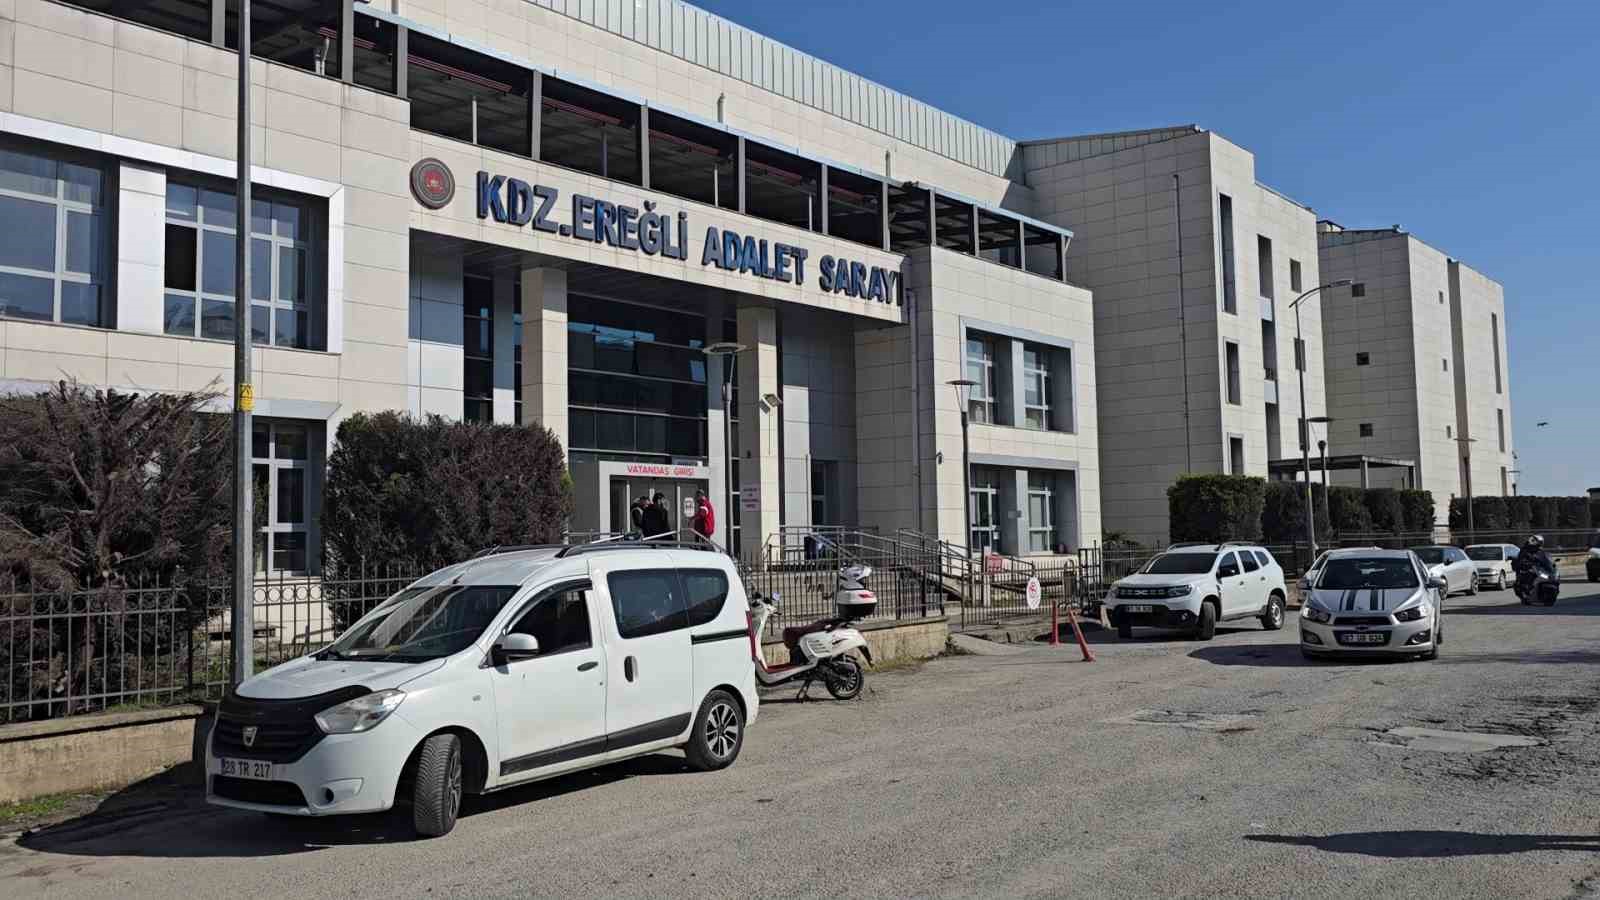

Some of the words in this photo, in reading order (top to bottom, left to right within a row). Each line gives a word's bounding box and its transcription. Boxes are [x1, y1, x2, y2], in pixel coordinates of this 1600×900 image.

[476, 170, 688, 261] KDZ.EREĞLİ
[701, 226, 808, 285] ADALET
[818, 254, 904, 306] SARAYI
[238, 761, 250, 776] TR
[254, 762, 271, 778] 217
